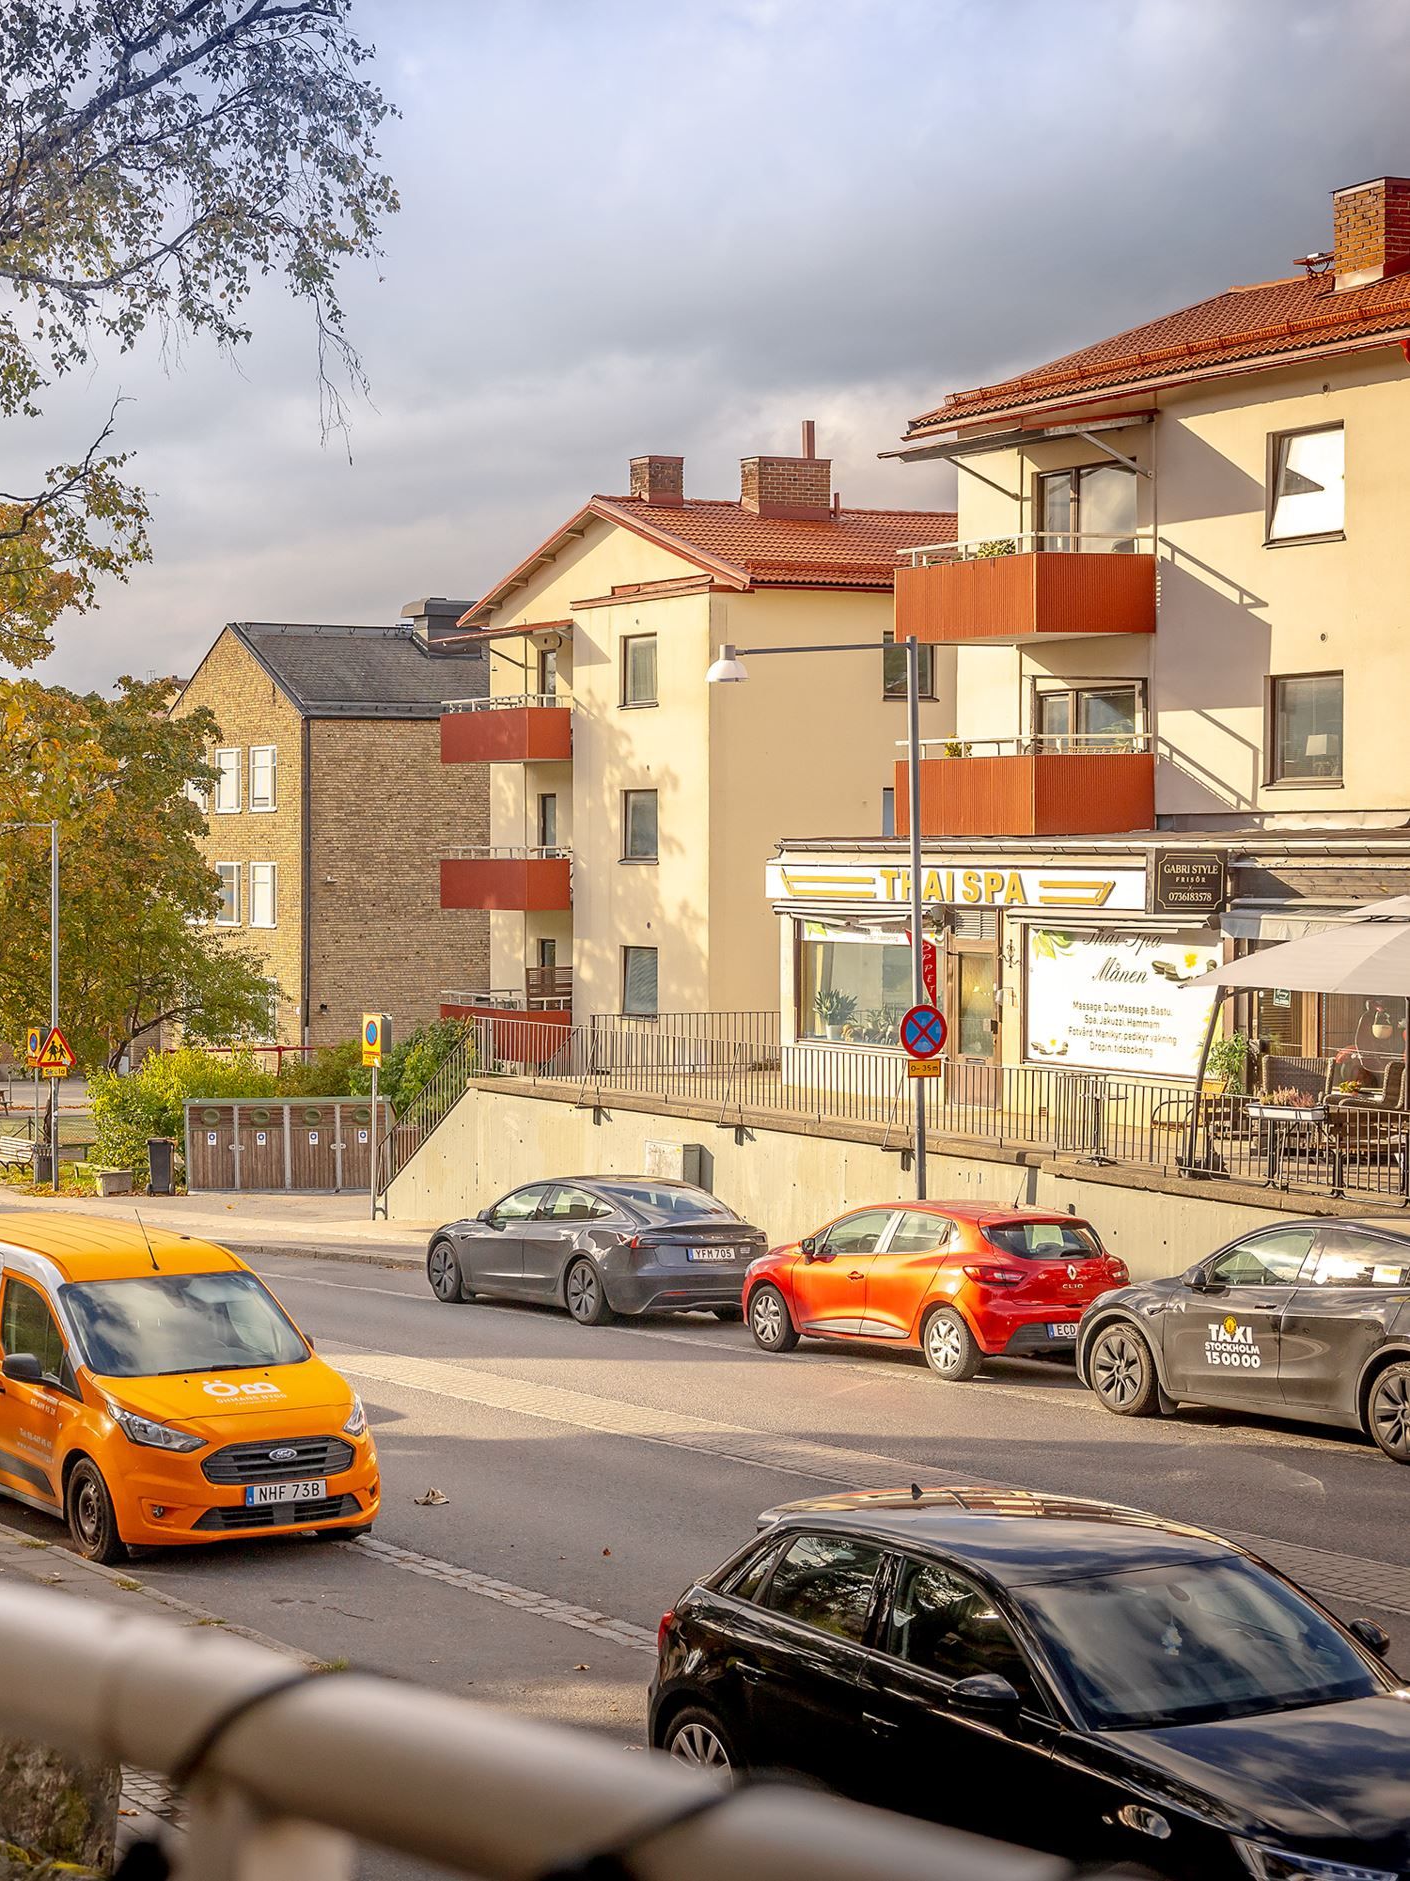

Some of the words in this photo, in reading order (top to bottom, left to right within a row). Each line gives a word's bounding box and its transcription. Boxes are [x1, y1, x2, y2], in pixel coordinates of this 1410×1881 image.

[1163, 864, 1190, 874] GABRI
[1191, 864, 1219, 875] STYLE
[1175, 875, 1206, 883] FRISÖR
[961, 870, 1028, 905] SPA
[1168, 892, 1212, 902] 0736183578
[1091, 957, 1149, 984] Månen
[695, 1248, 714, 1259] YFM
[714, 1248, 733, 1259] 705
[1056, 1324, 1077, 1336] ECD
[1207, 1323, 1254, 1344] TAXI
[1204, 1341, 1261, 1355] STOCKHOLM
[259, 1485, 287, 1502] NHF
[292, 1482, 320, 1499] 73B
